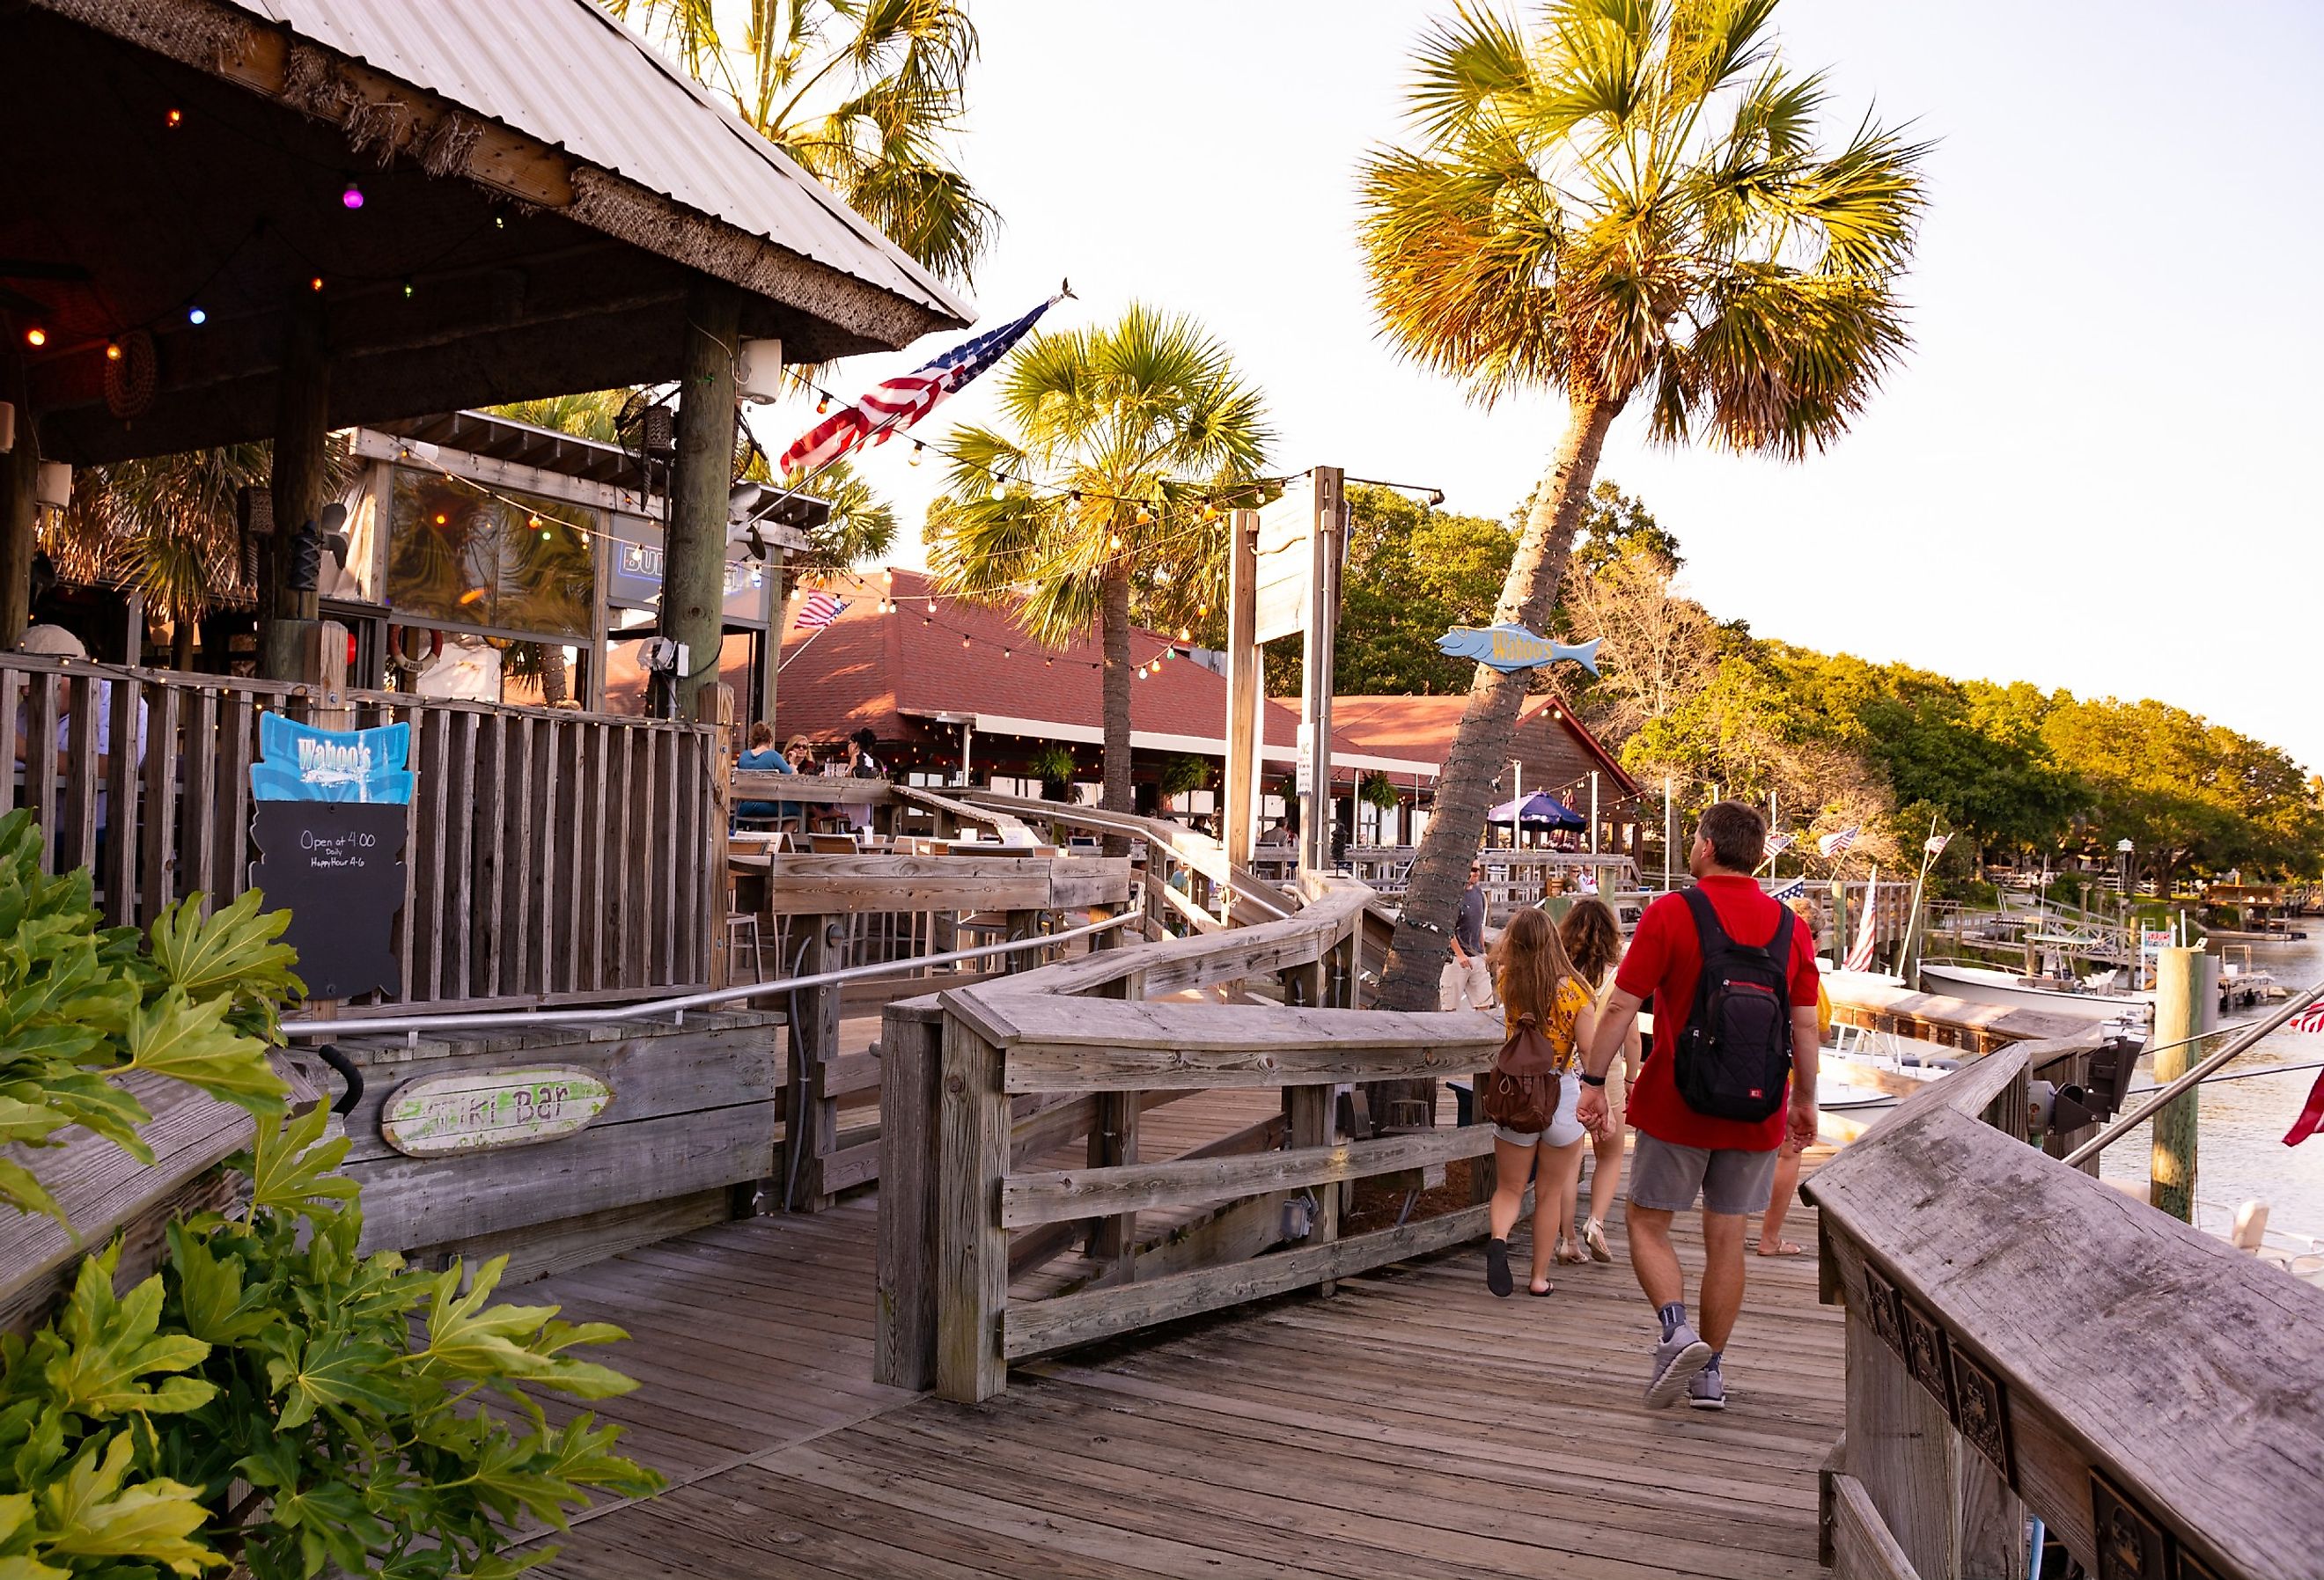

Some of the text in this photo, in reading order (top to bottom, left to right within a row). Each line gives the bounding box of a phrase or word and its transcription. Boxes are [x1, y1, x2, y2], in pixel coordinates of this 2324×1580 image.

[1492, 630, 1553, 661] Wahoo's
[298, 739, 371, 770] Wahoo's
[300, 829, 333, 851] Open
[335, 835, 346, 847] at
[325, 848, 342, 856] Daily
[311, 856, 365, 868] Happy Hour 4-6
[512, 1086, 570, 1125] Bar
